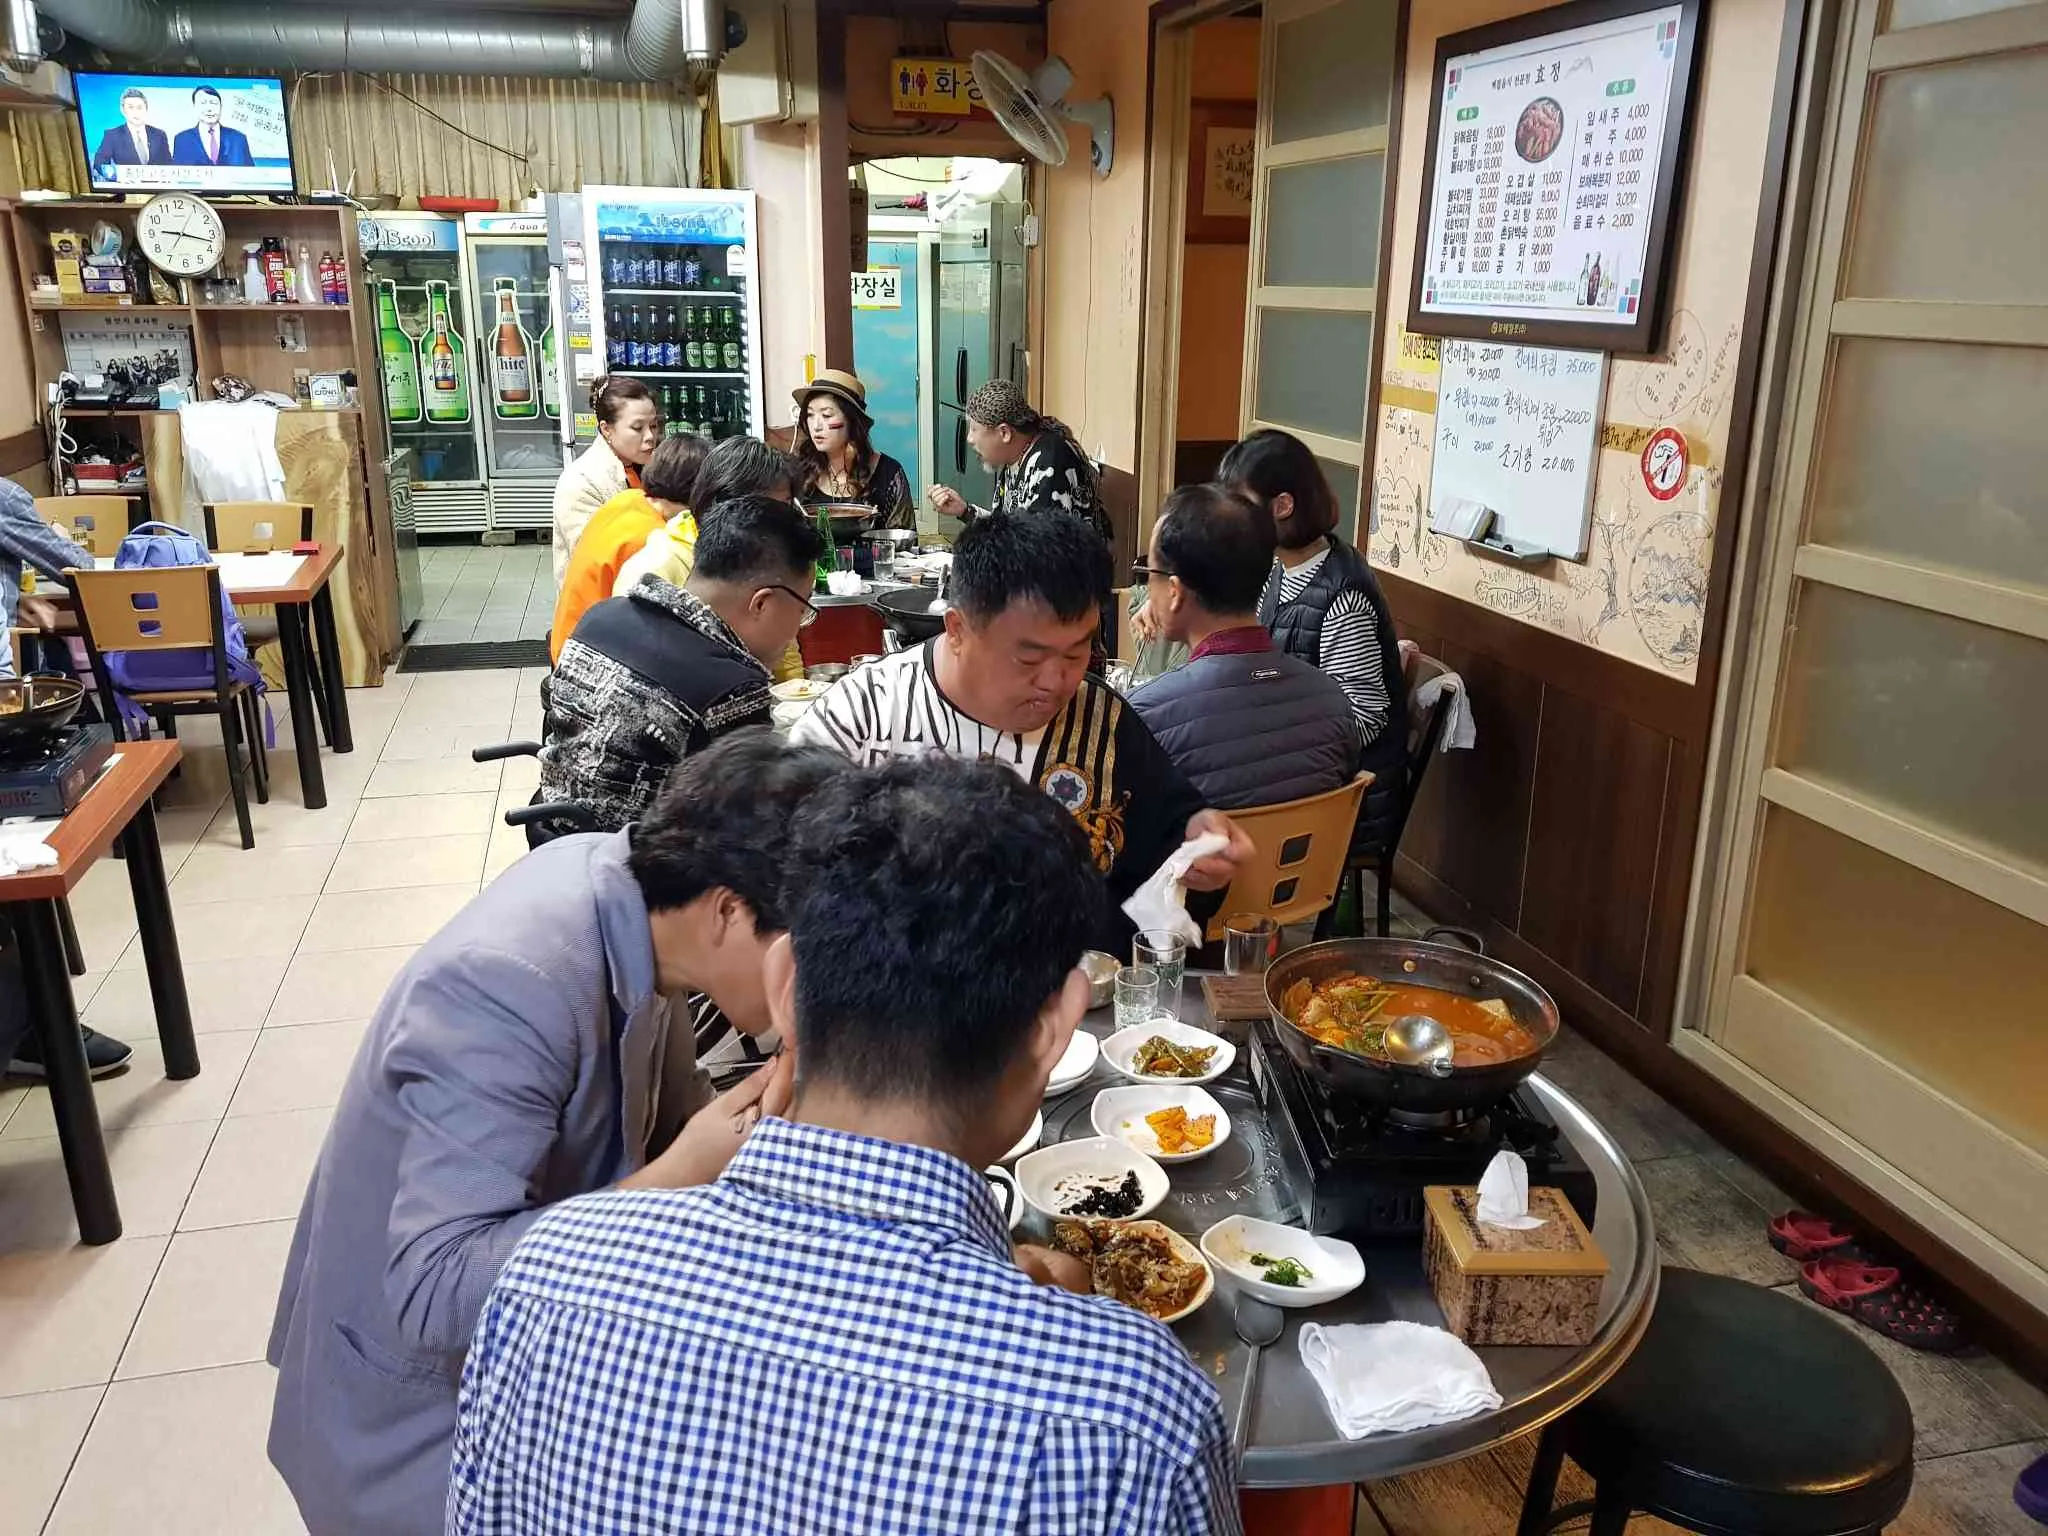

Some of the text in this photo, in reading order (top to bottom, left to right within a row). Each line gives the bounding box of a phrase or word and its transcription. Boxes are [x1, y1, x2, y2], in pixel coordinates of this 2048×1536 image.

[1628, 104, 1649, 120] 4,000
[1625, 126, 1647, 142] 4,000
[1619, 149, 1643, 164] 10,000
[1616, 170, 1640, 186] 12,000
[160, 204, 168, 213] 11
[173, 200, 184, 209] 12
[193, 205, 197, 214] 1
[150, 215, 160, 224] 10
[203, 215, 210, 224] 2
[1612, 213, 1634, 228] 2,000
[148, 229, 155, 238] 9
[209, 230, 215, 239] 3
[155, 244, 161, 253] 8
[207, 244, 212, 253] 4
[167, 255, 172, 263] 7
[183, 259, 189, 267] 6
[198, 255, 203, 264] 5
[500, 357, 525, 370] hite
